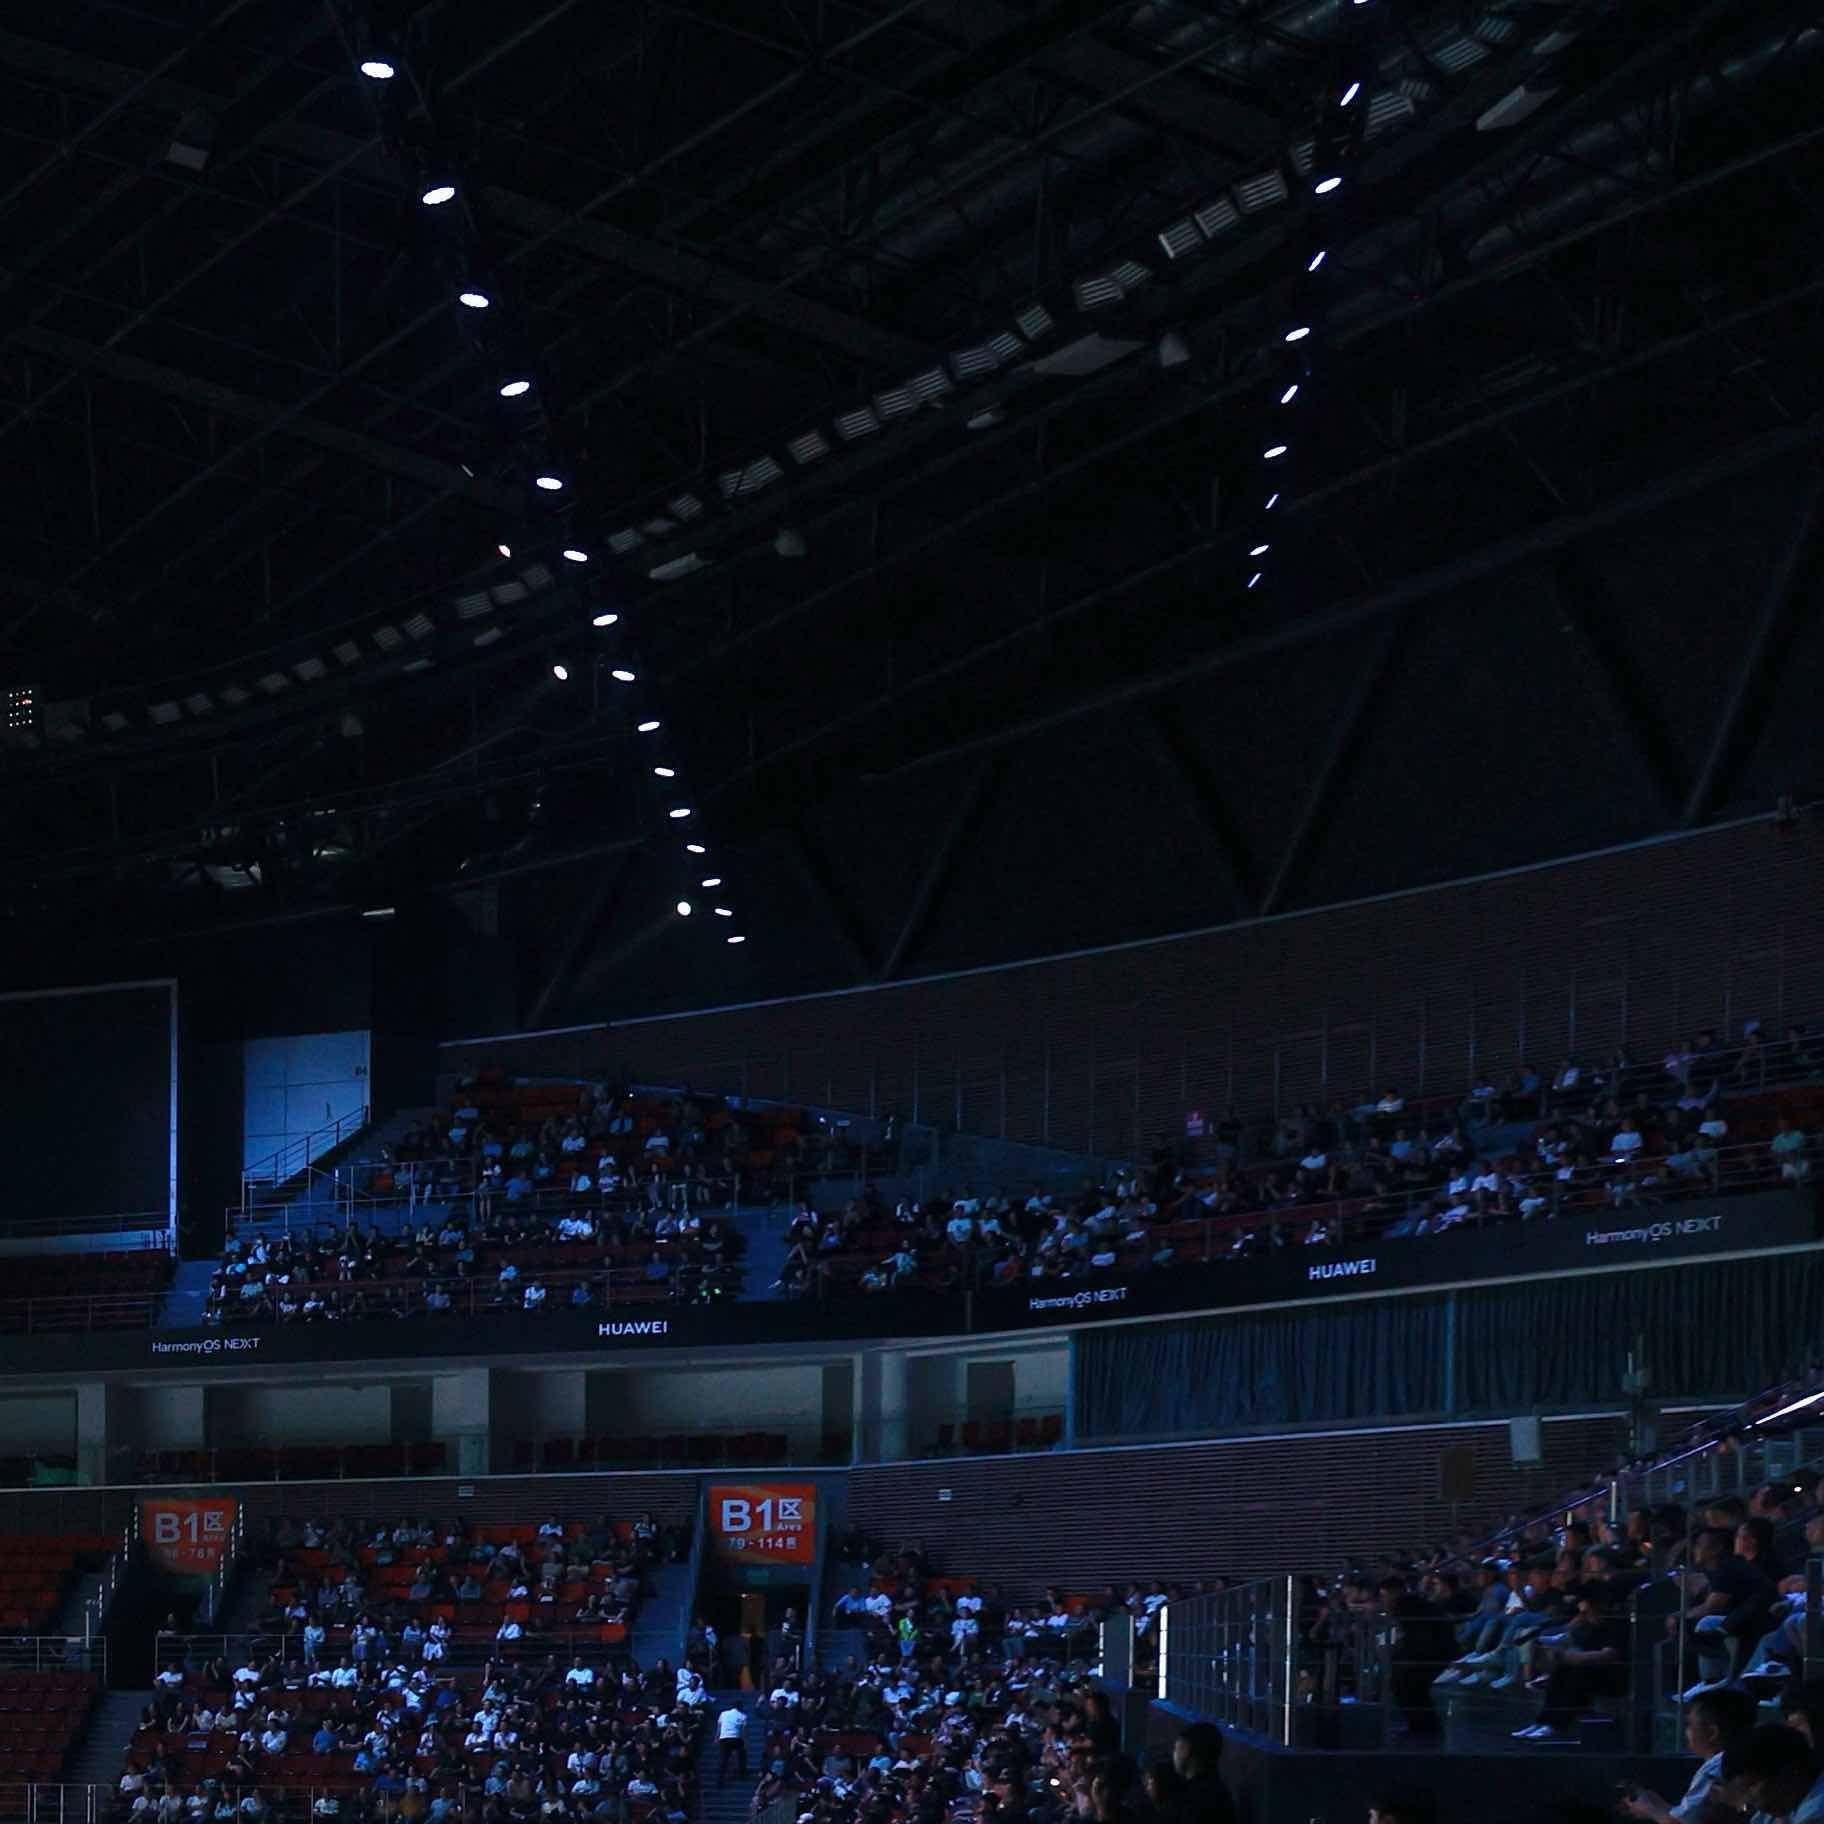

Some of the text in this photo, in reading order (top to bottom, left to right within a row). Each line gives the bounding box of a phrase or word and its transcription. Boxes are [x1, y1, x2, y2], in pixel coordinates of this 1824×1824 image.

[1586, 1221, 1672, 1245] HarmonyOS
[1309, 1258, 1377, 1280] HUAWEI
[598, 1320, 668, 1336] HUAWEI
[152, 1338, 222, 1354] HarmonyOS
